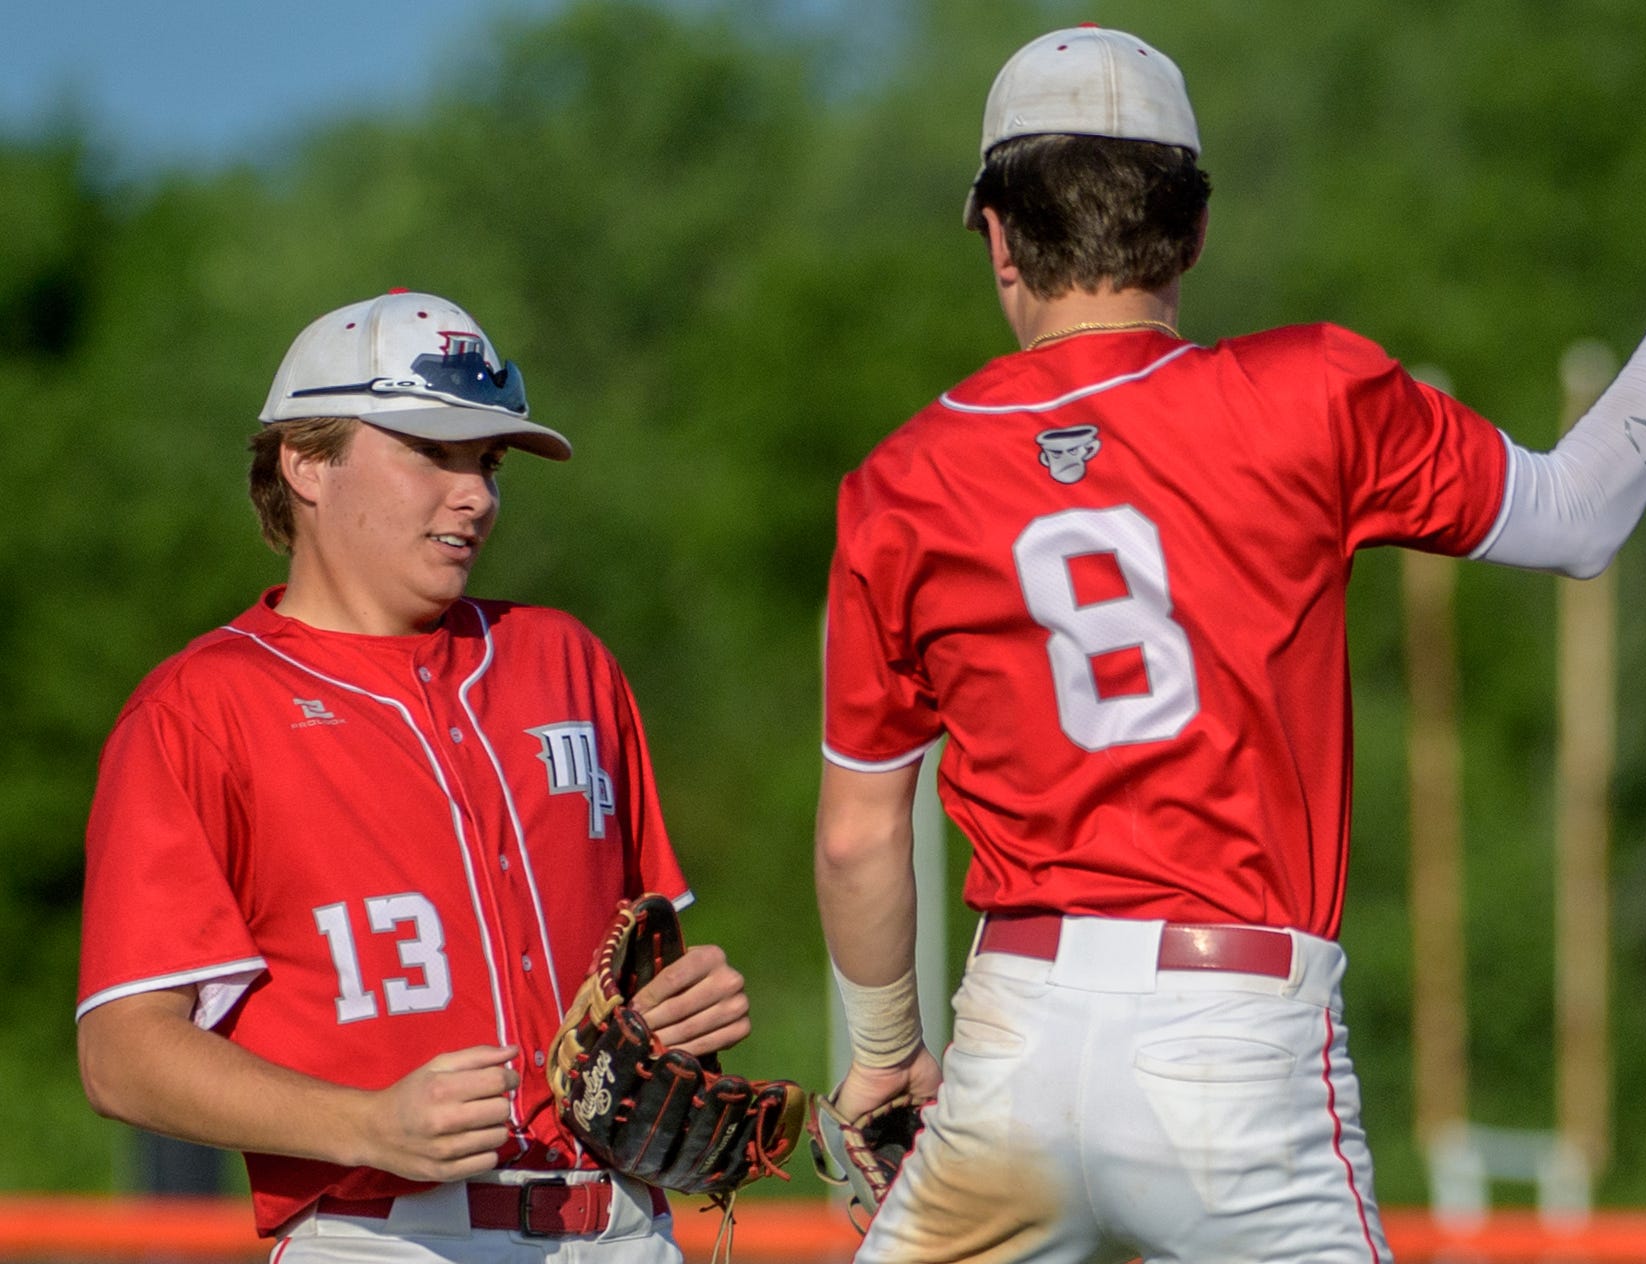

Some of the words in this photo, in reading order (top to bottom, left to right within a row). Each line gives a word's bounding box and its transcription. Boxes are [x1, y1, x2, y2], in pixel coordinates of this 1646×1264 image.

[1011, 502, 1201, 753] 8
[311, 890, 454, 1025] 13
[572, 1049, 617, 1133] Rawlings
